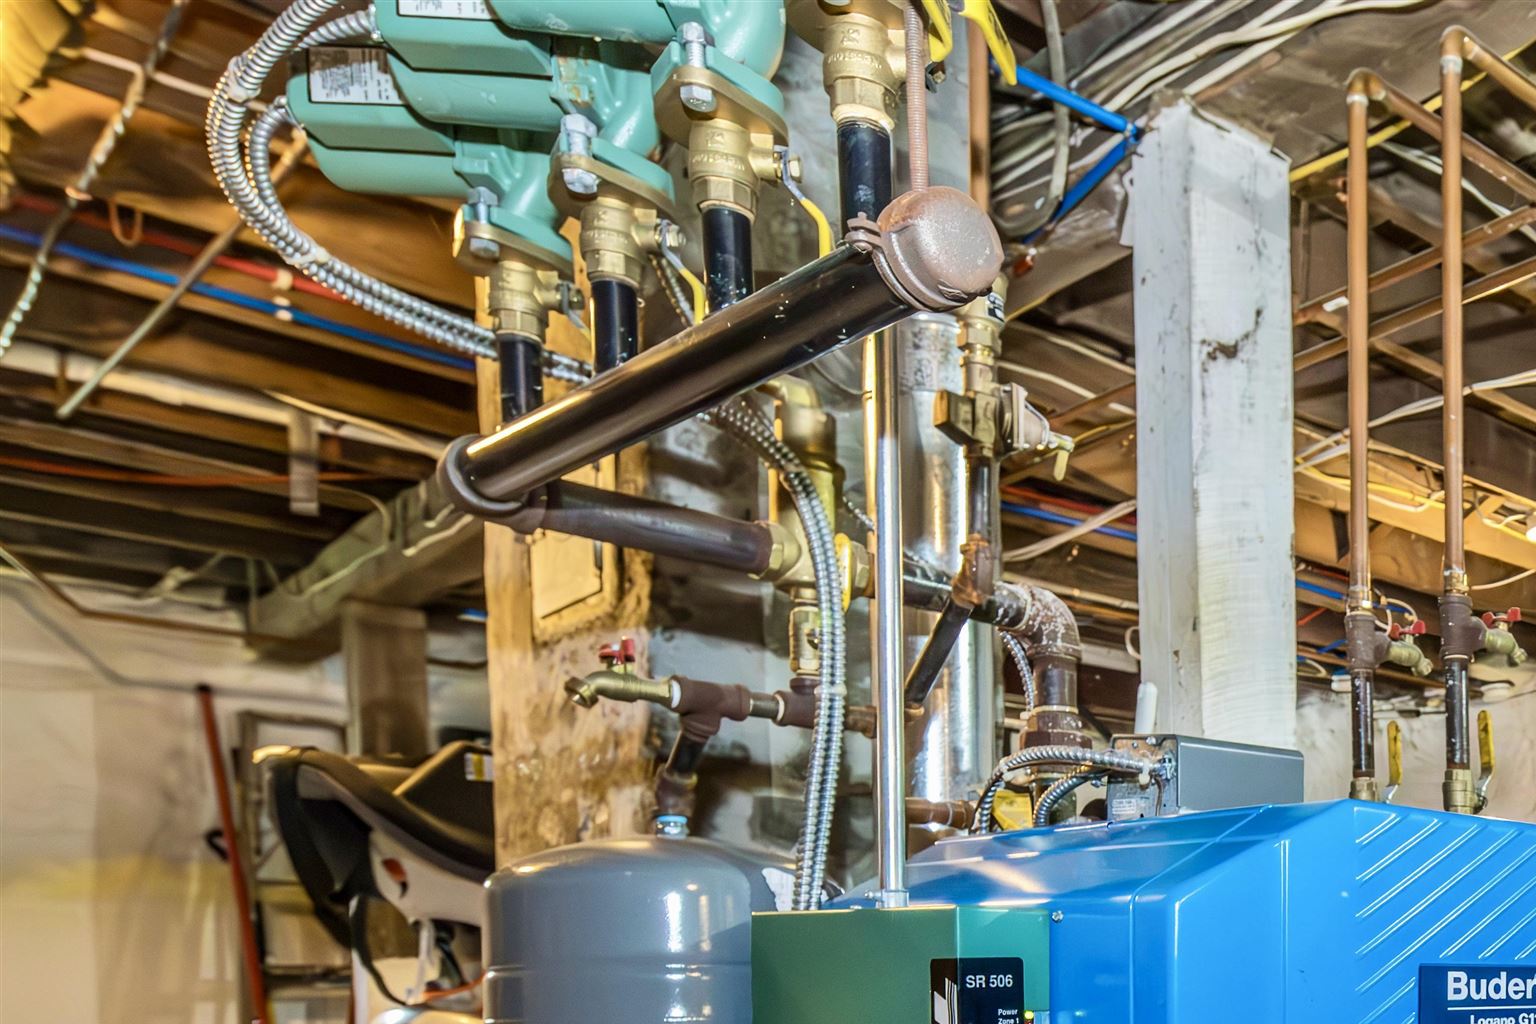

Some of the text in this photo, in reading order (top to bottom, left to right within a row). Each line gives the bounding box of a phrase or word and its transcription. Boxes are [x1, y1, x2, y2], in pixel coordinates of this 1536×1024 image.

[965, 974, 1013, 988] SR 506
[997, 1008, 1018, 1016] Power
